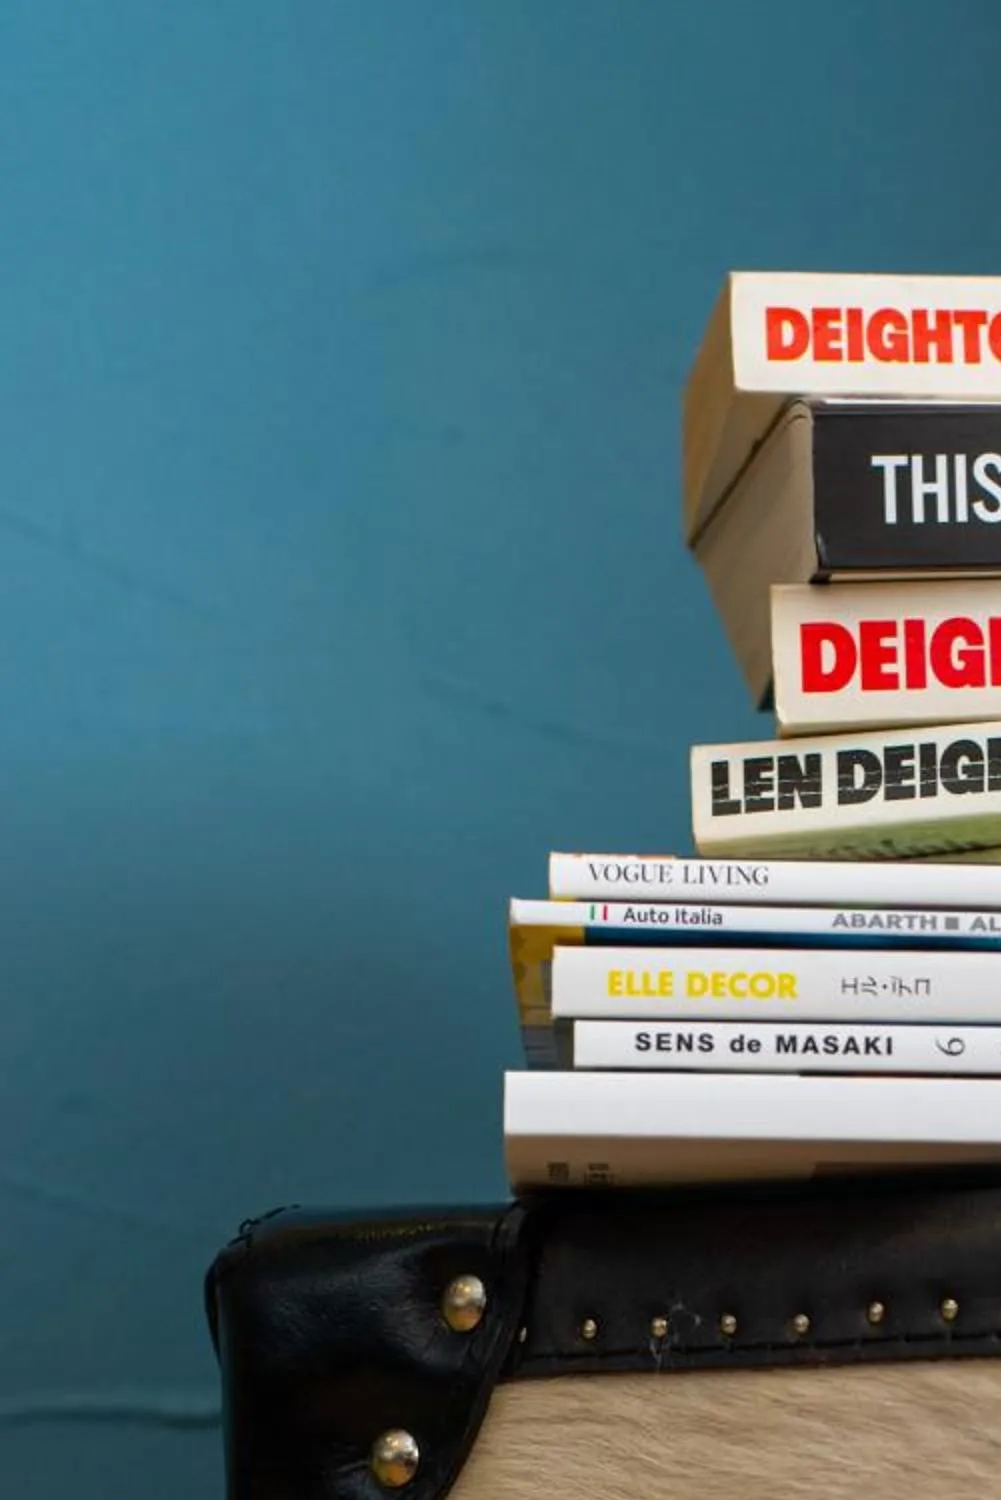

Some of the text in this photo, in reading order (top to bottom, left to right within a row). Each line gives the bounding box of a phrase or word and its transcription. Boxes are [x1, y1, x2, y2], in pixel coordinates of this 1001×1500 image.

[711, 753, 822, 816] LEN
[589, 864, 768, 885] VOGUE LIVING
[624, 908, 723, 926] Auto Italia
[832, 913, 937, 931] ABARTH
[608, 970, 797, 998] ELLE DECOR
[842, 977, 930, 996] エル・デコ
[636, 1033, 892, 1055] SENS de MASAKI
